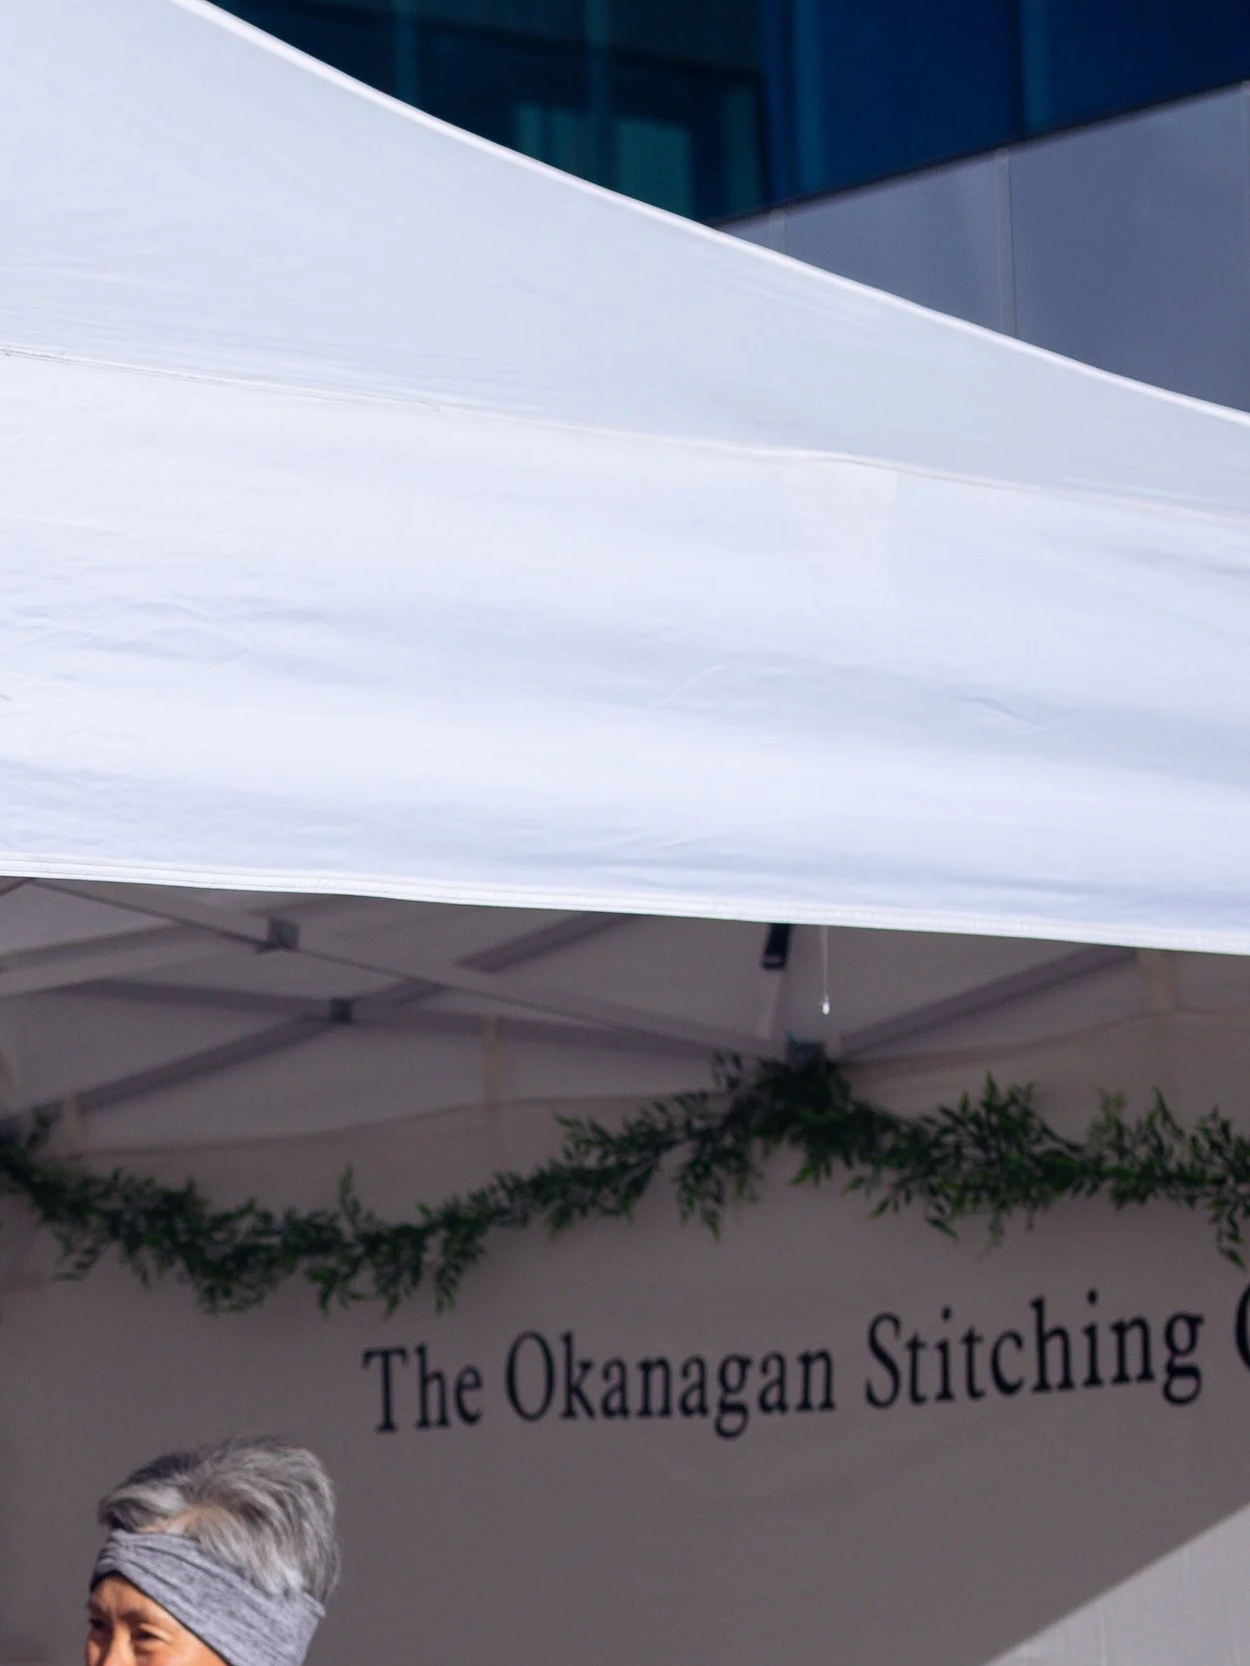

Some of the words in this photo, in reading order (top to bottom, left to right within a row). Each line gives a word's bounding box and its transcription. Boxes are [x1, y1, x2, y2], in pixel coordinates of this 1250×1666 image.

[362, 1341, 484, 1433] The
[505, 1329, 836, 1440] Okanagan
[864, 1286, 1206, 1408] Stitching
